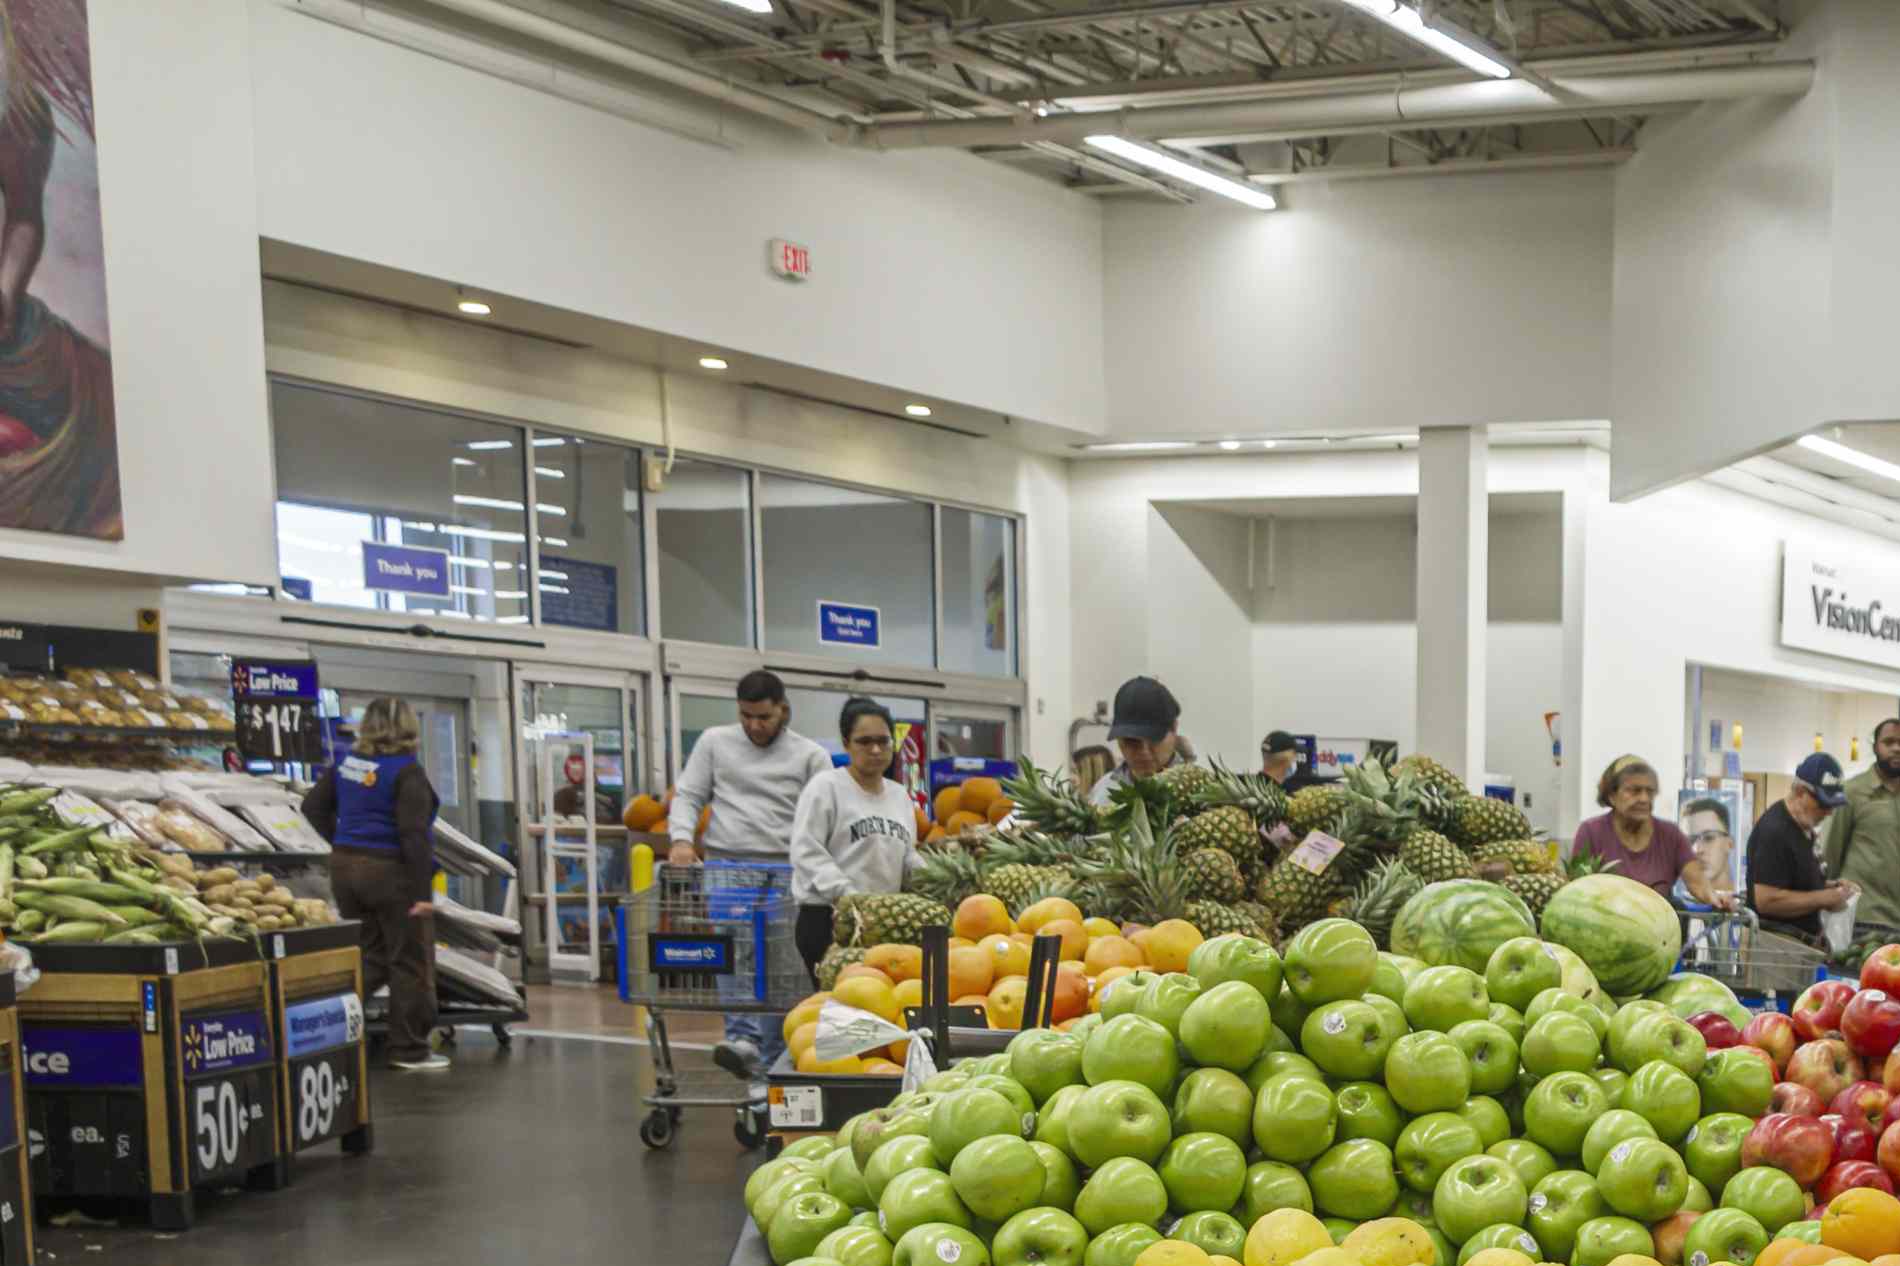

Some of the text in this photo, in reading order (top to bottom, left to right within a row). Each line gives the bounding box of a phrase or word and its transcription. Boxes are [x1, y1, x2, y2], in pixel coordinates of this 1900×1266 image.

[783, 243, 809, 276] EXIT
[377, 558, 438, 583] Thank you
[249, 672, 299, 692] Low Price
[204, 1028, 256, 1060] Low Price
[71, 1125, 105, 1143] ea.
[116, 1133, 130, 1159] USA
